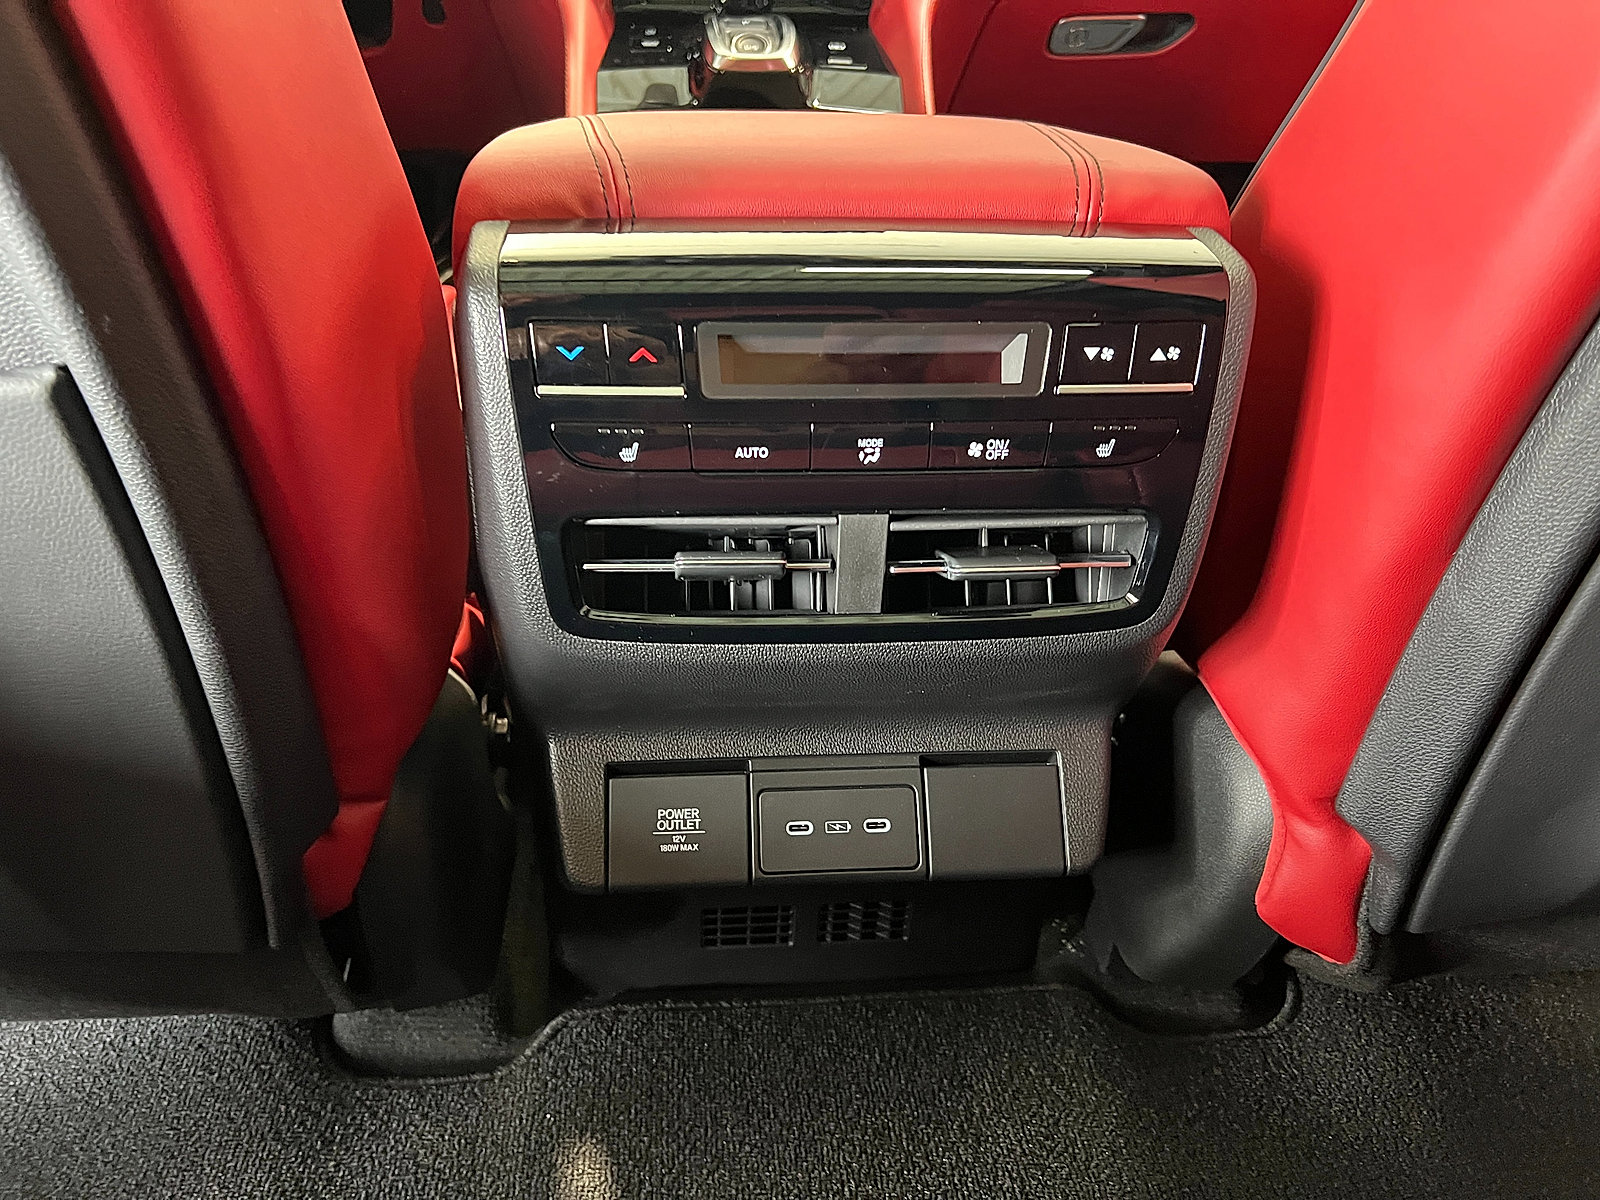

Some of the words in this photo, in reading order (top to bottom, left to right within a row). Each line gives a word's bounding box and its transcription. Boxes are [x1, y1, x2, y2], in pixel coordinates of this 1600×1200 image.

[857, 438, 884, 448] MODE
[986, 438, 1010, 450] ON/
[734, 446, 769, 459] AUTO
[985, 449, 1009, 461] OFF
[657, 808, 700, 820] POWER
[656, 818, 702, 831] OUTLET
[672, 835, 686, 843] 12V
[659, 844, 679, 852] 180W
[680, 843, 699, 851] MAX
